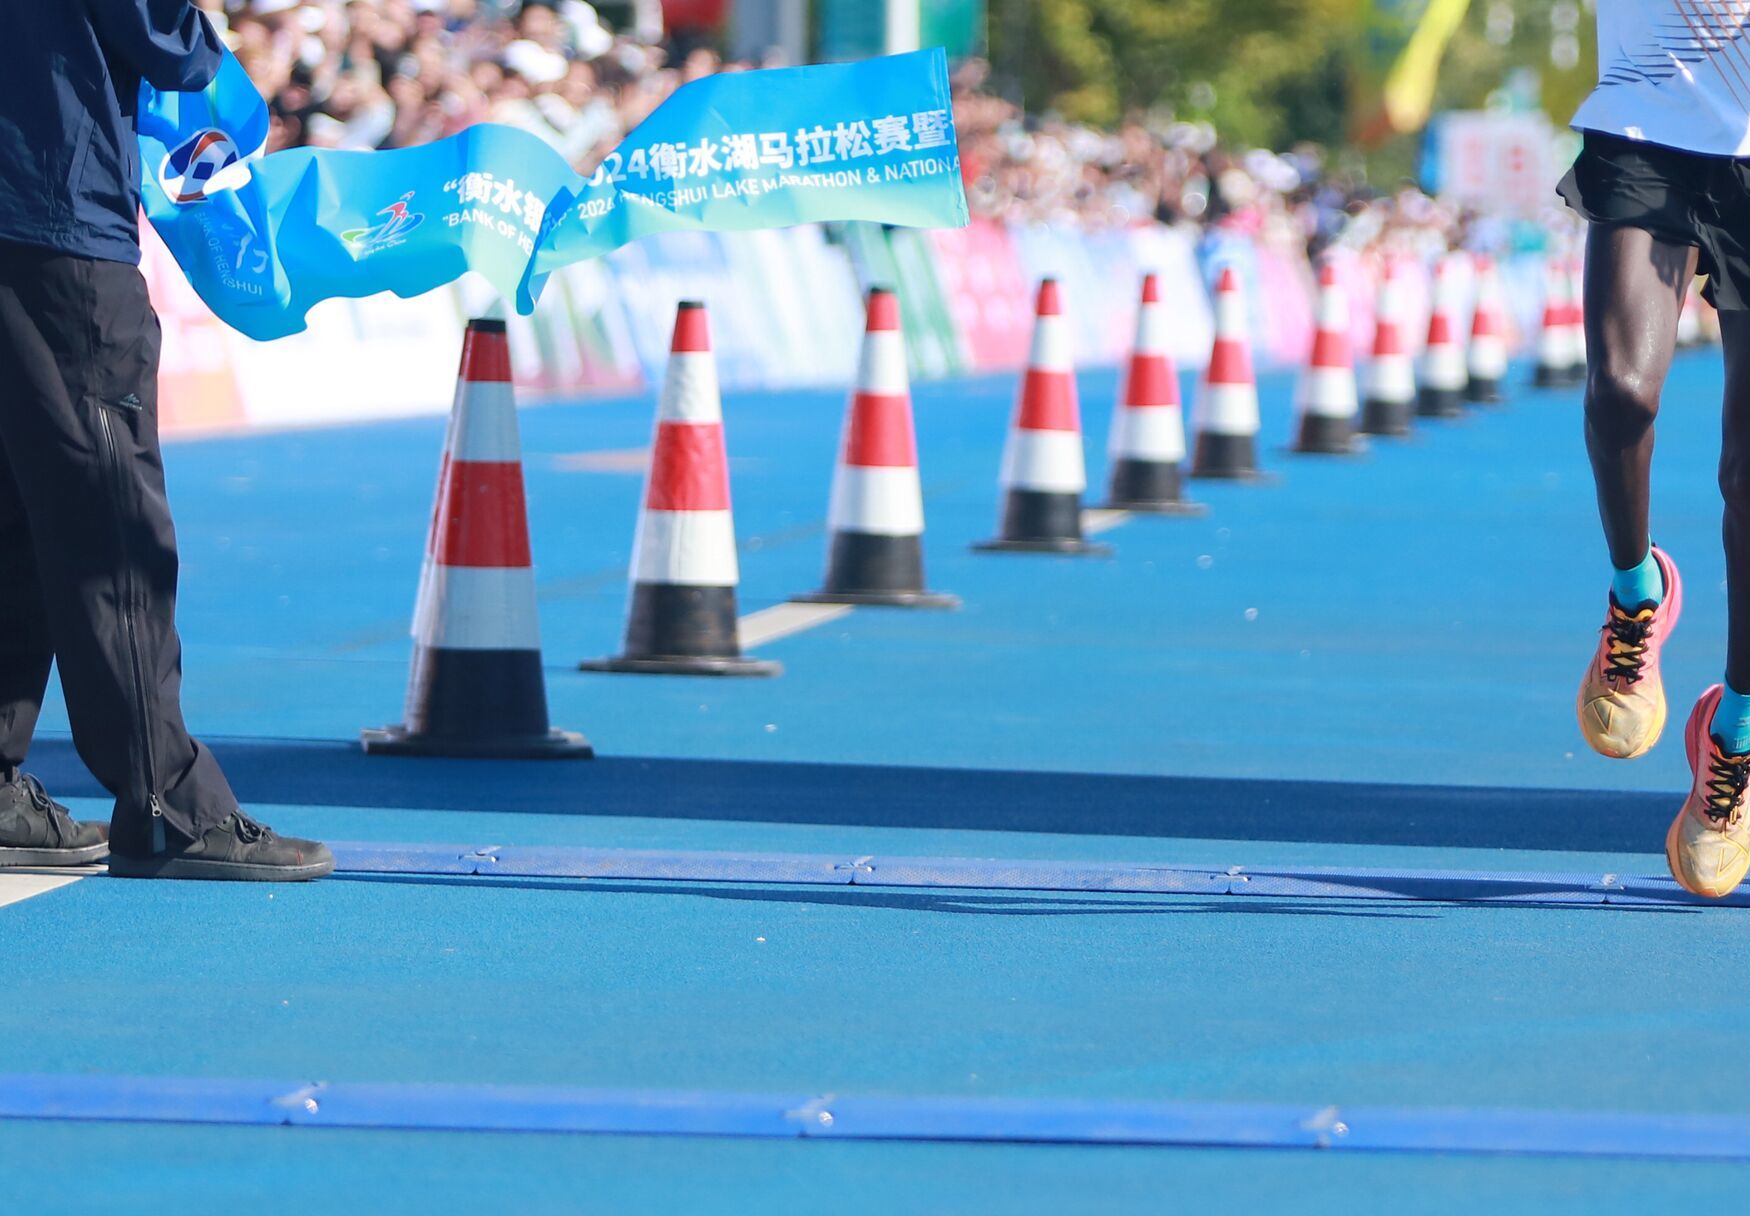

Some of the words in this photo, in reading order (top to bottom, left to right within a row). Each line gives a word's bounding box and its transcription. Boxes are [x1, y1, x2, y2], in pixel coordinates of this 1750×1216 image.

[577, 196, 615, 220] 2024
[619, 186, 708, 213] HENGSHUI
[712, 178, 760, 199] LAKE
[762, 168, 862, 193] MARATHON
[866, 166, 880, 184] &
[498, 219, 517, 240] OF
[207, 238, 223, 254] OF
